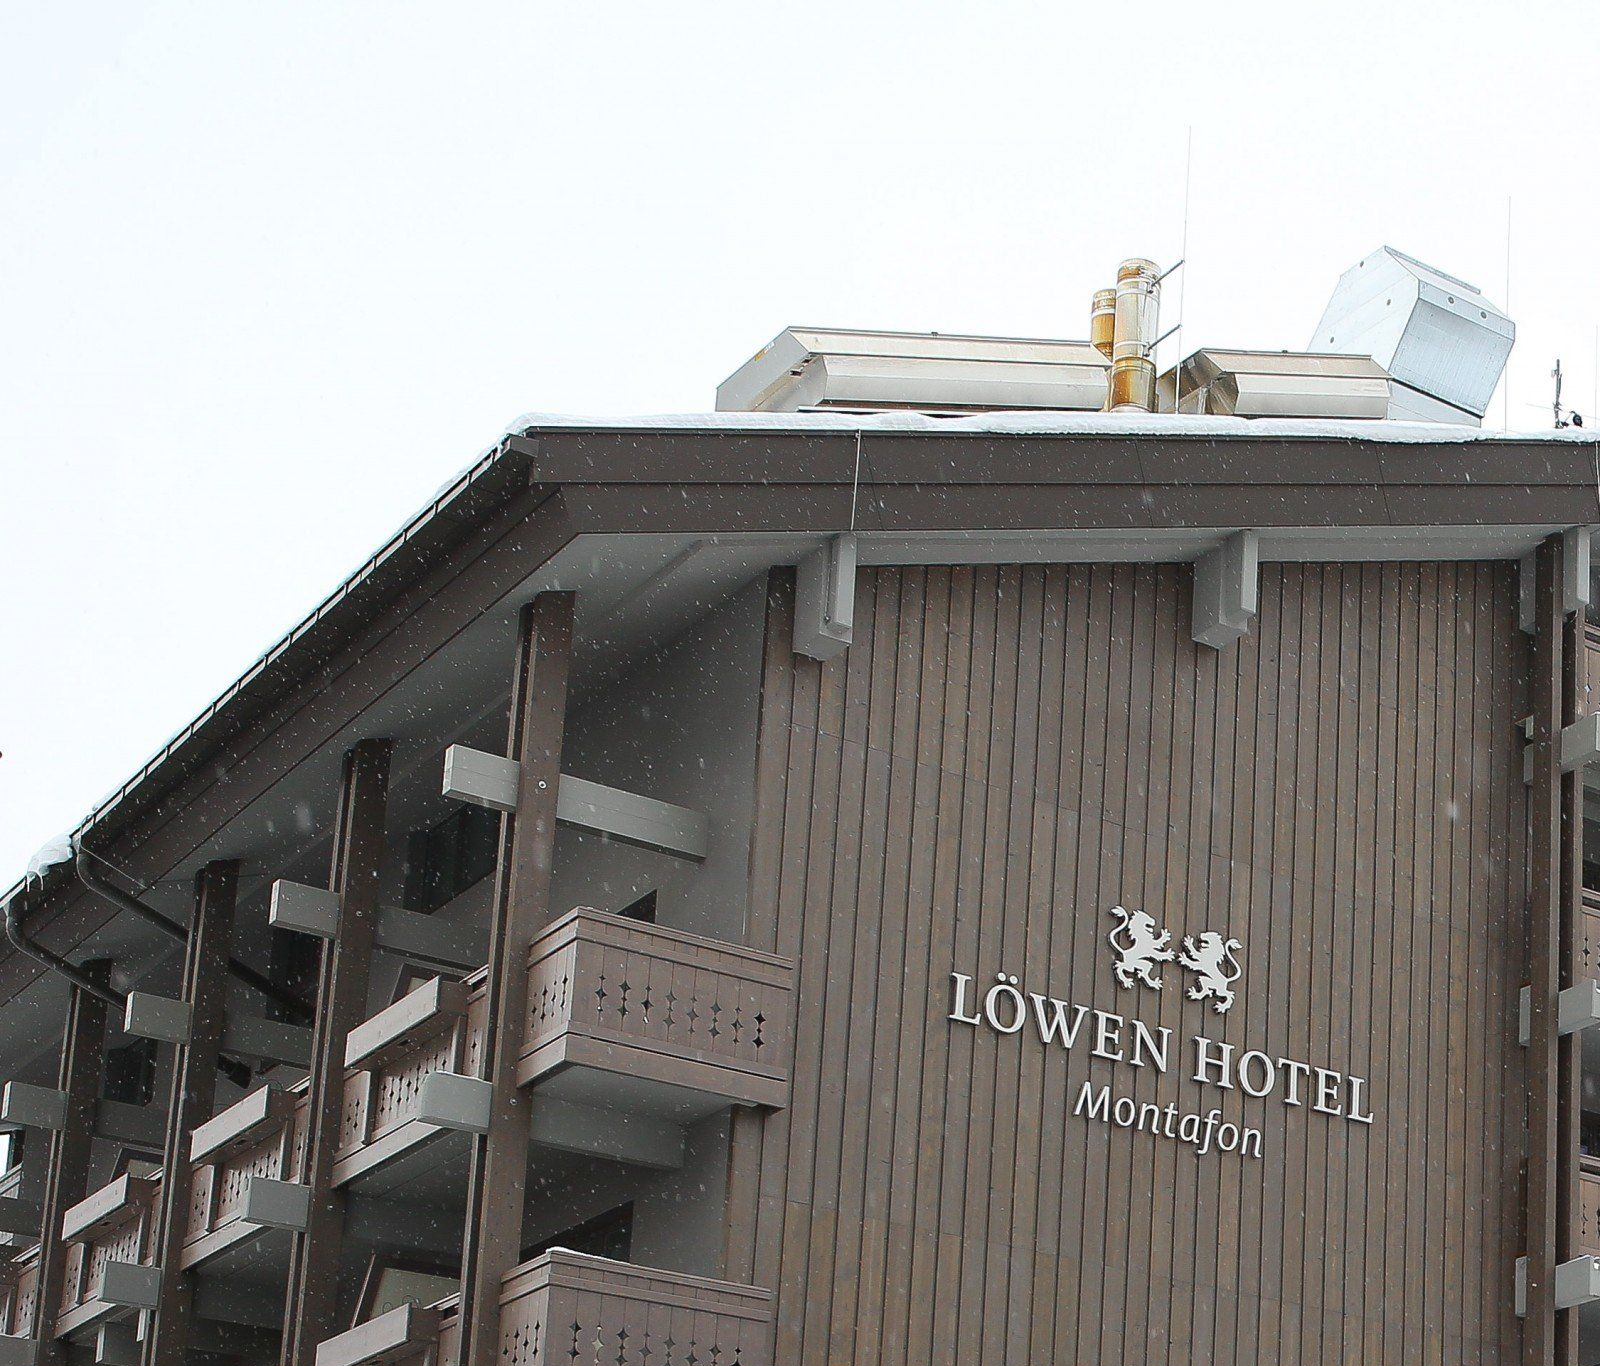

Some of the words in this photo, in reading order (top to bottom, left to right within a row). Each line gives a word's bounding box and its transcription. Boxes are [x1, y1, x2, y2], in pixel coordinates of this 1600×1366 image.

[948, 971, 1173, 1073] LÖWEN
[1192, 1035, 1375, 1124] HOTEL
[1073, 1081, 1263, 1159] Montafon
